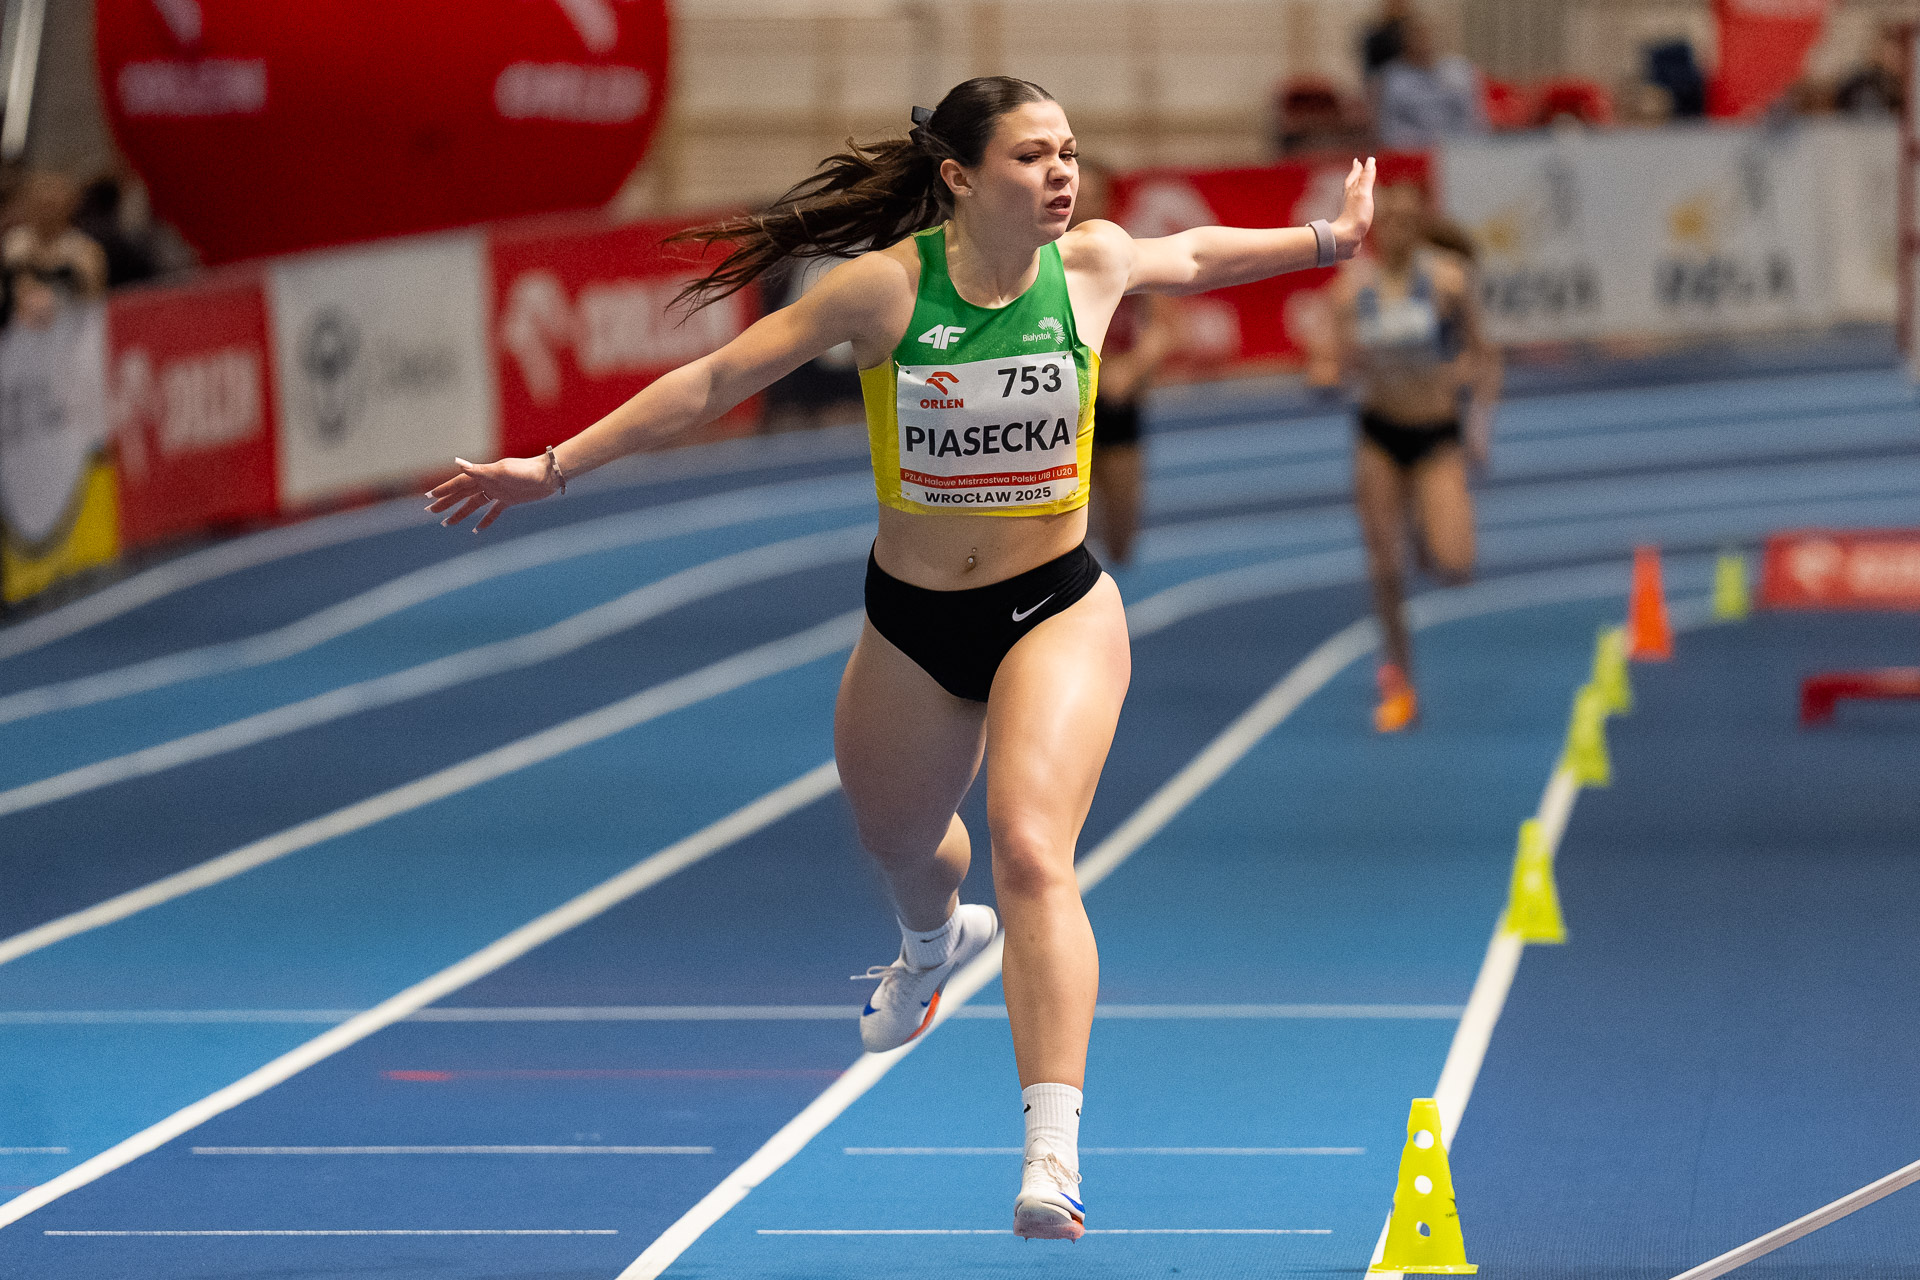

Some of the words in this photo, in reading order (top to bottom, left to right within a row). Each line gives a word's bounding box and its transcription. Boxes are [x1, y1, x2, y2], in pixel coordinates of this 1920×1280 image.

[918, 324, 967, 350] 4F
[1022, 331, 1052, 343] Białystok
[997, 363, 1062, 398] 753
[919, 398, 964, 409] ORLEN
[905, 417, 1071, 458] PIASECKA
[904, 472, 923, 483] PZLA
[924, 477, 956, 487] Halowe
[958, 475, 1010, 486] Mistrzostwa
[1011, 474, 1037, 483] Polski
[1038, 471, 1051, 480] U18
[1056, 467, 1073, 477] U20
[924, 491, 1012, 504] WROCŁAW
[1015, 486, 1051, 502] 2025
